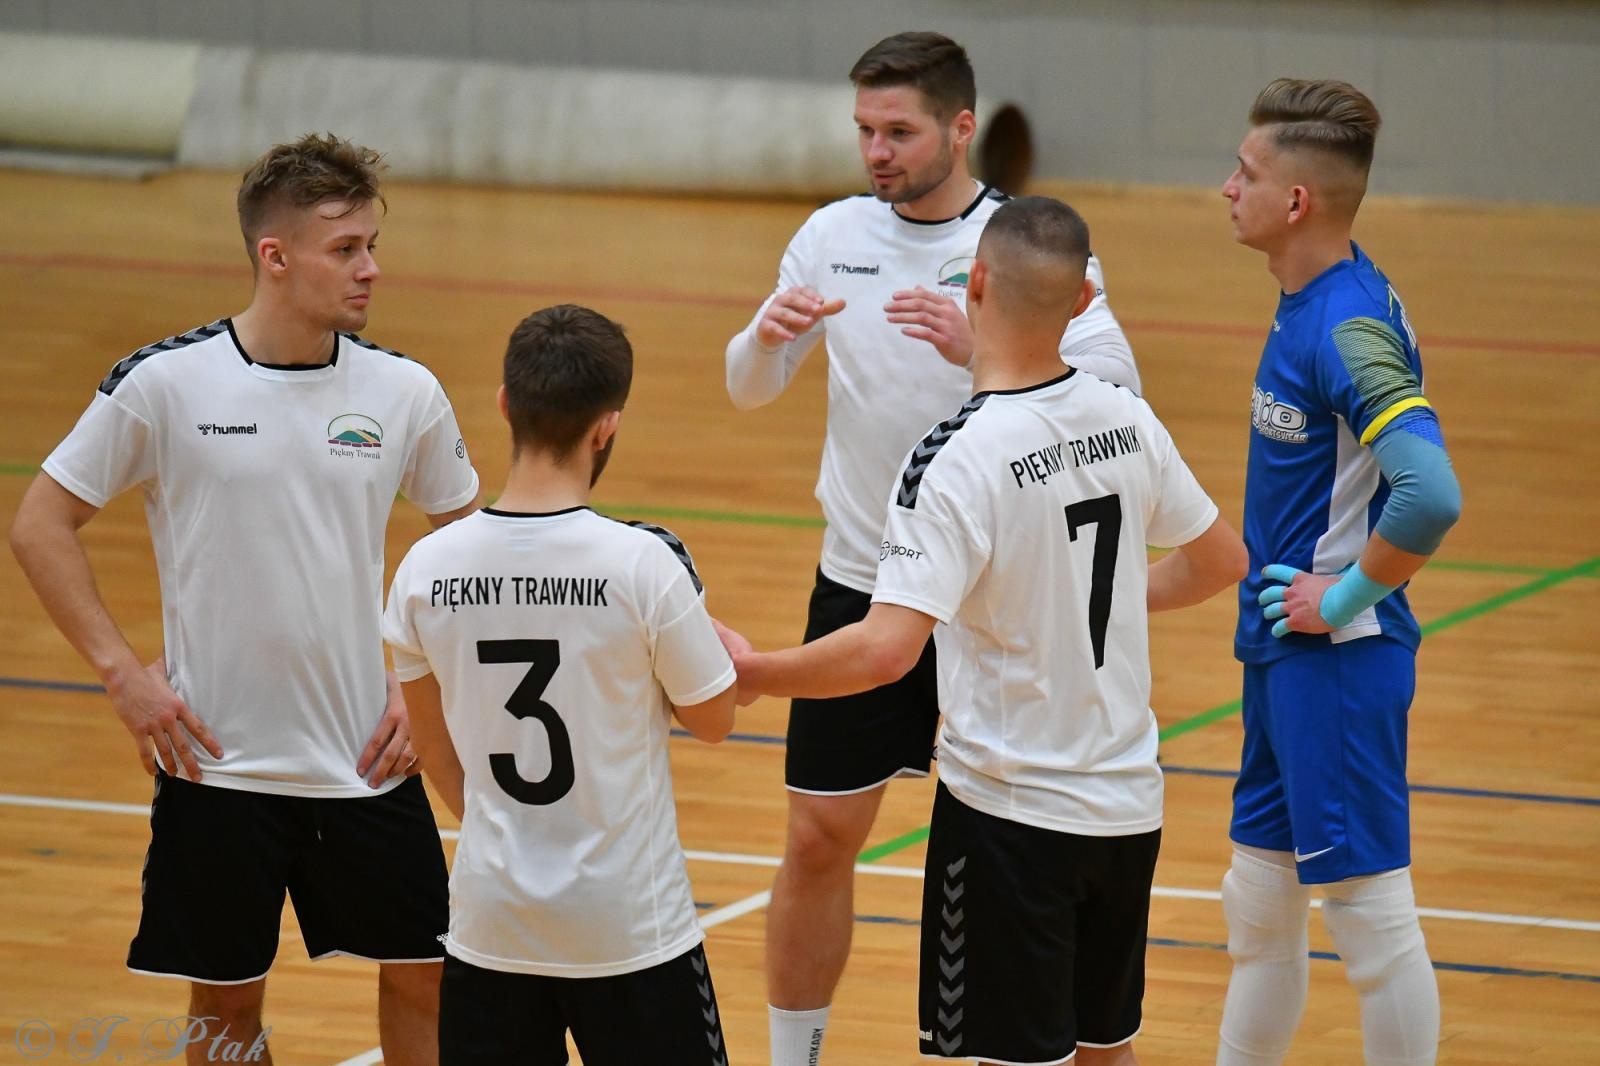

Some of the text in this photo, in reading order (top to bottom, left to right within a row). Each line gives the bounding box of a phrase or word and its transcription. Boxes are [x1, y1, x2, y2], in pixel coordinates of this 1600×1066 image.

[841, 263, 879, 276] hummel
[212, 423, 257, 435] hummel
[329, 448, 381, 460] Piękny Trawnik
[1009, 425, 1142, 489] PIĘKNY TRAWNIK
[890, 545, 923, 560] SPORT
[1064, 493, 1122, 670] 7
[431, 577, 608, 613] PIĘKNY TRAWNIK
[476, 639, 575, 806] 3
